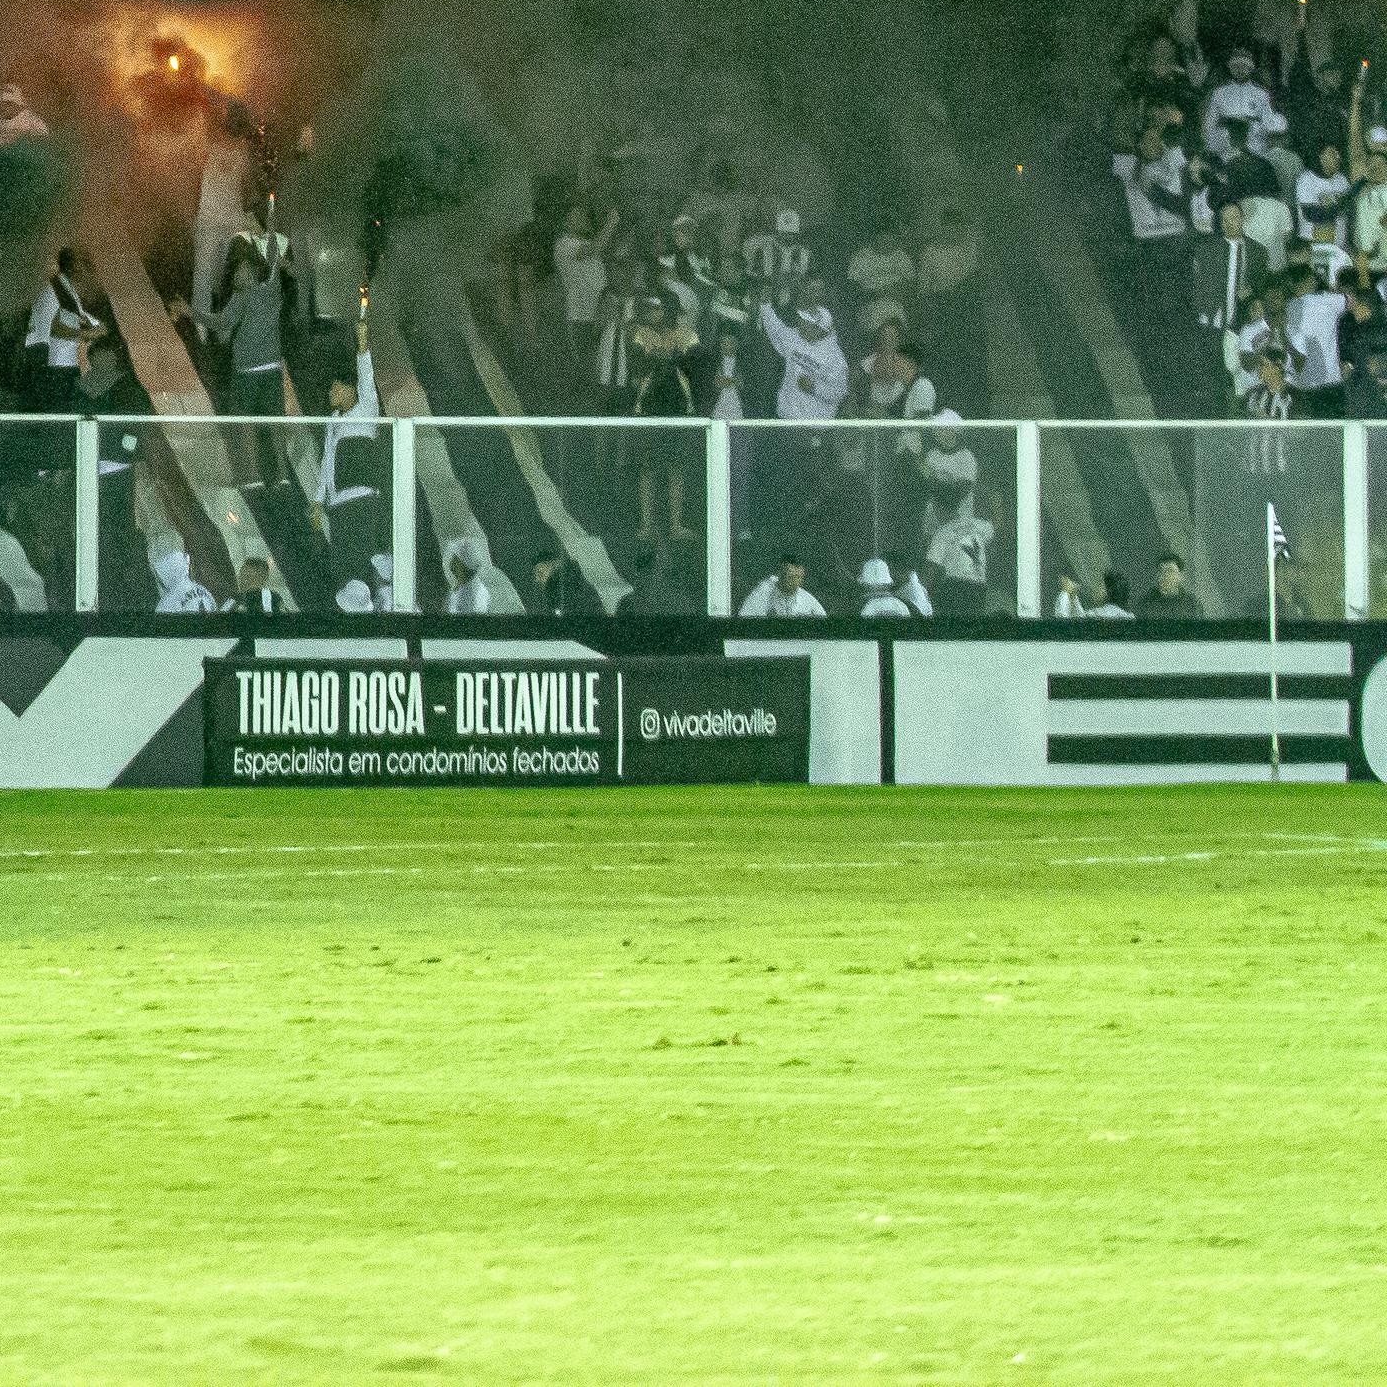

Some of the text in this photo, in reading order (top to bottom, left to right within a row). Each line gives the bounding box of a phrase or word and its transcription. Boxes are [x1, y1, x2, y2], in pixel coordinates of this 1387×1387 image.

[235, 670, 339, 735] THIAGO
[350, 670, 424, 735] ROSA
[456, 670, 600, 735] DELTAVILLE
[663, 708, 777, 737] vivadeltaville
[233, 745, 600, 781] Especialista em condomínios fechados
